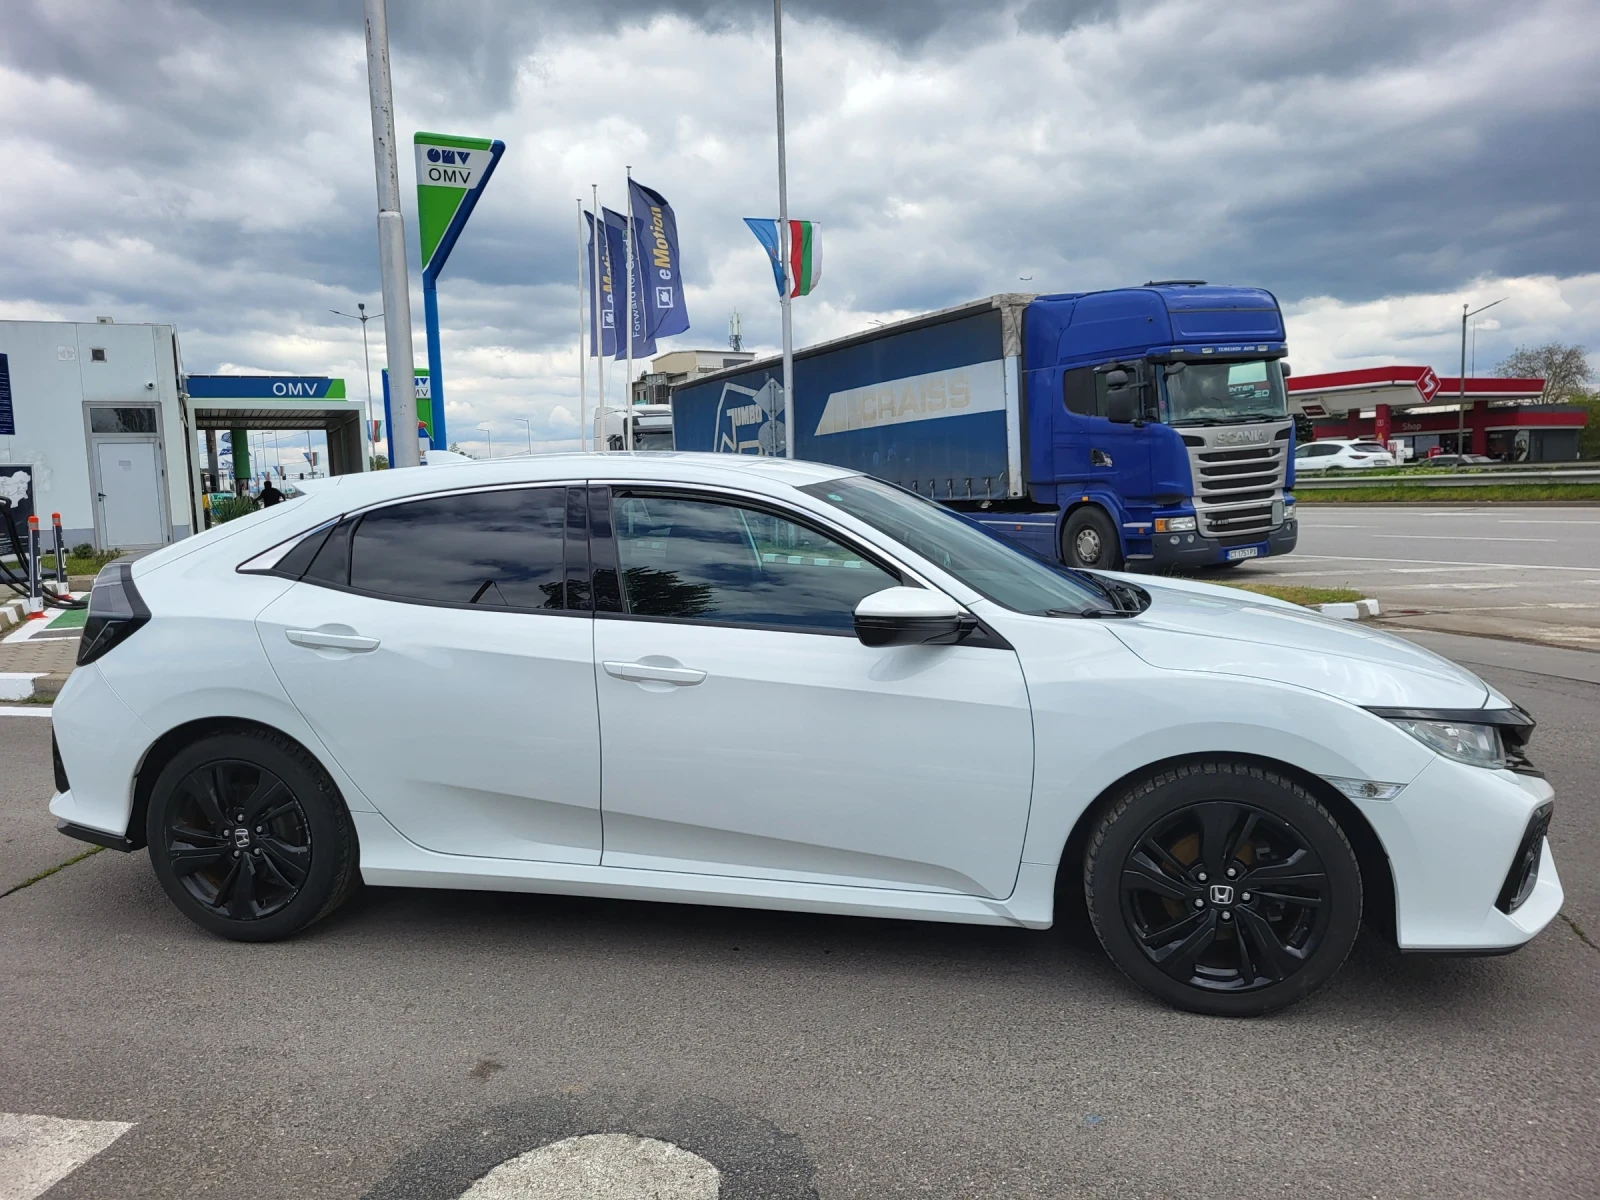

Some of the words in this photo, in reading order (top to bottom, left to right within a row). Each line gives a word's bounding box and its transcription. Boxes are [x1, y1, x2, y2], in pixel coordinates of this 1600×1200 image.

[428, 168, 471, 184] OMV
[650, 206, 671, 280] eMotion
[273, 382, 318, 396] OMV
[415, 389, 428, 397] MV
[862, 373, 971, 423] CRAISS
[1402, 422, 1422, 431] Shop
[1217, 430, 1265, 444] SCANIA
